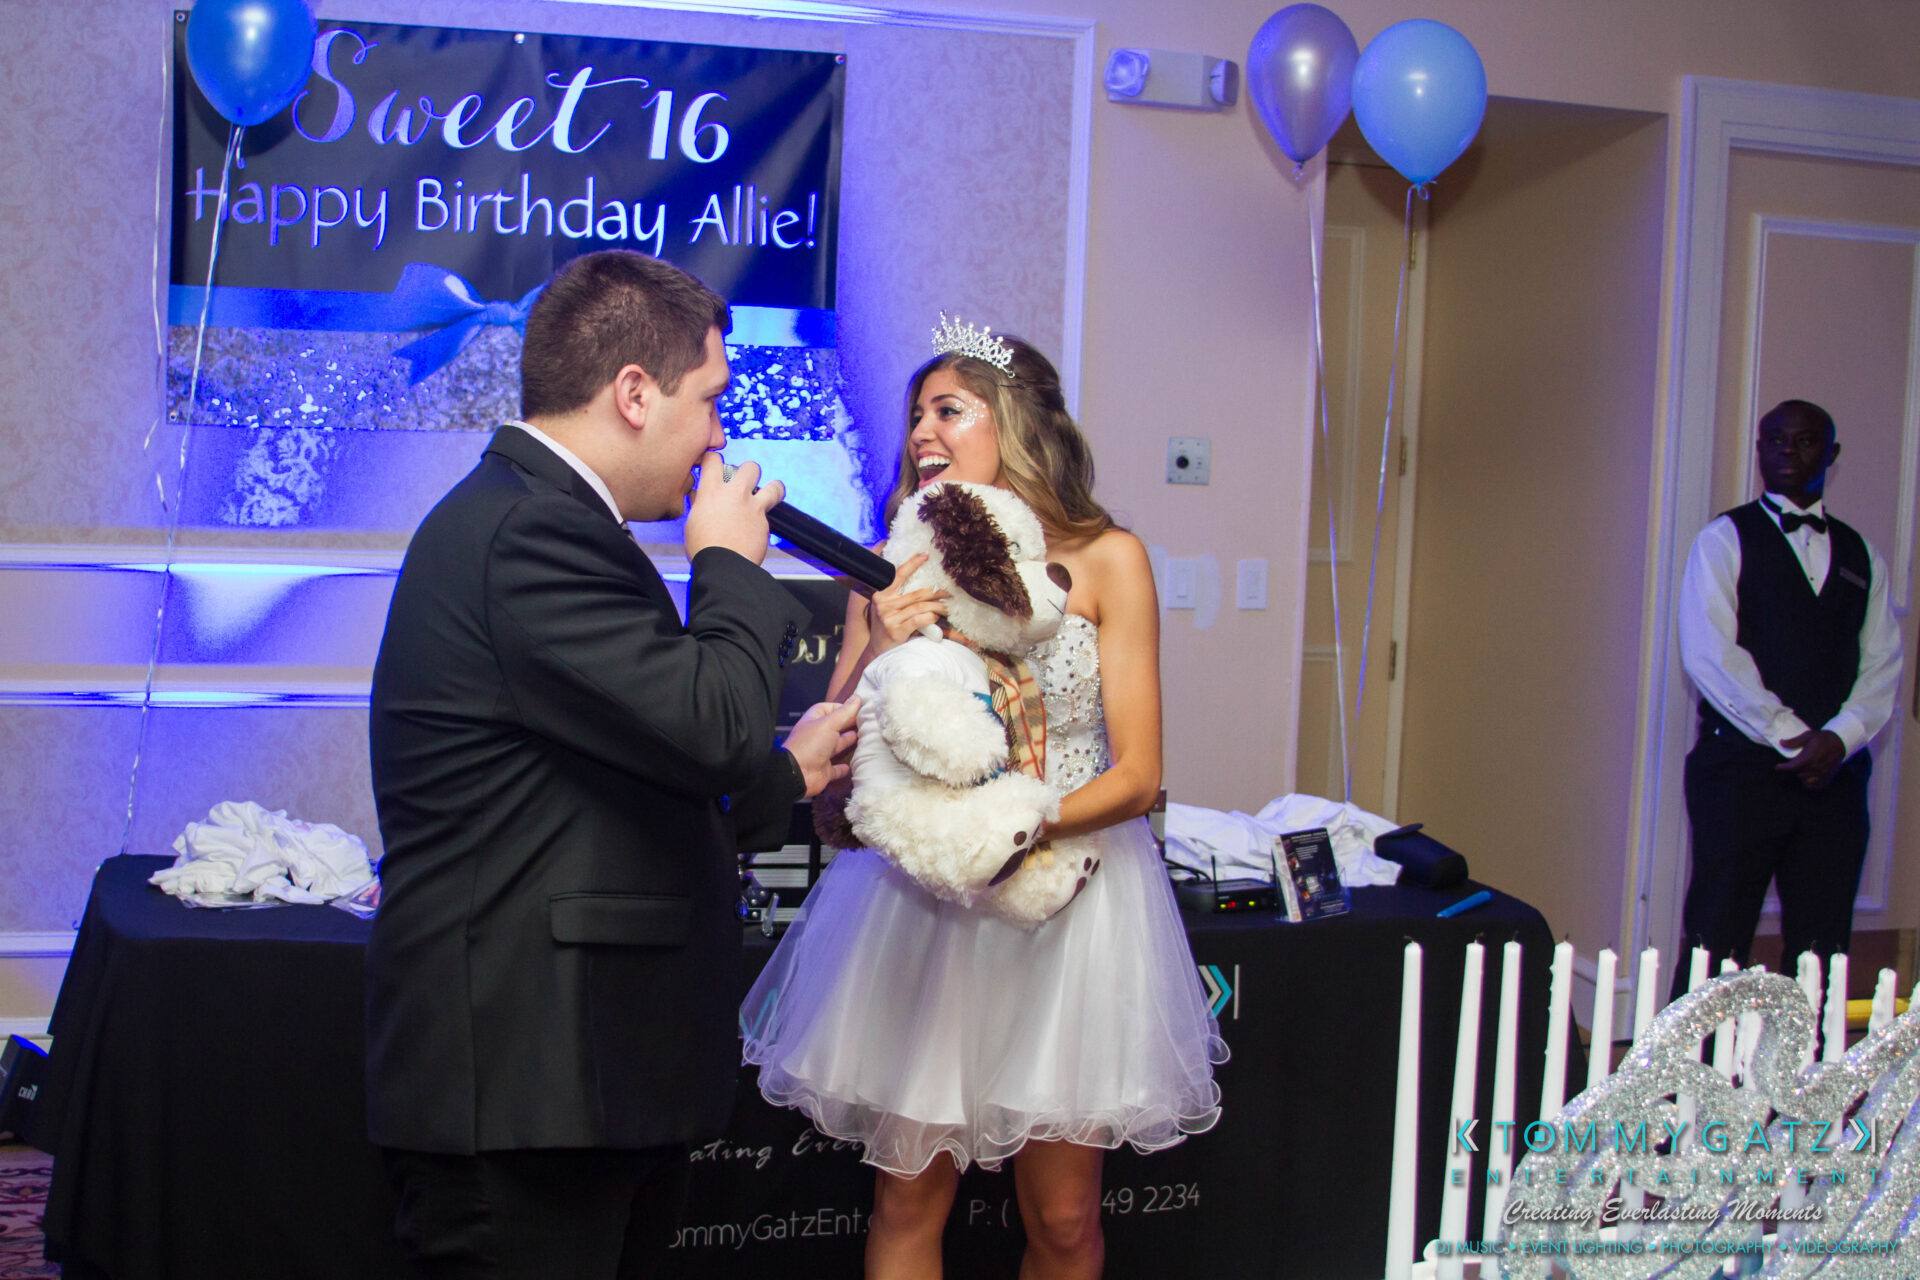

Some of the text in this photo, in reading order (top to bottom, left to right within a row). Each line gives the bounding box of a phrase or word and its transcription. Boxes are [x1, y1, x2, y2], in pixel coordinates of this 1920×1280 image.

[292, 28, 731, 163] Sweet 16
[185, 167, 818, 258] Happy Birthday Allie!
[1143, 1182, 1200, 1213] 2234
